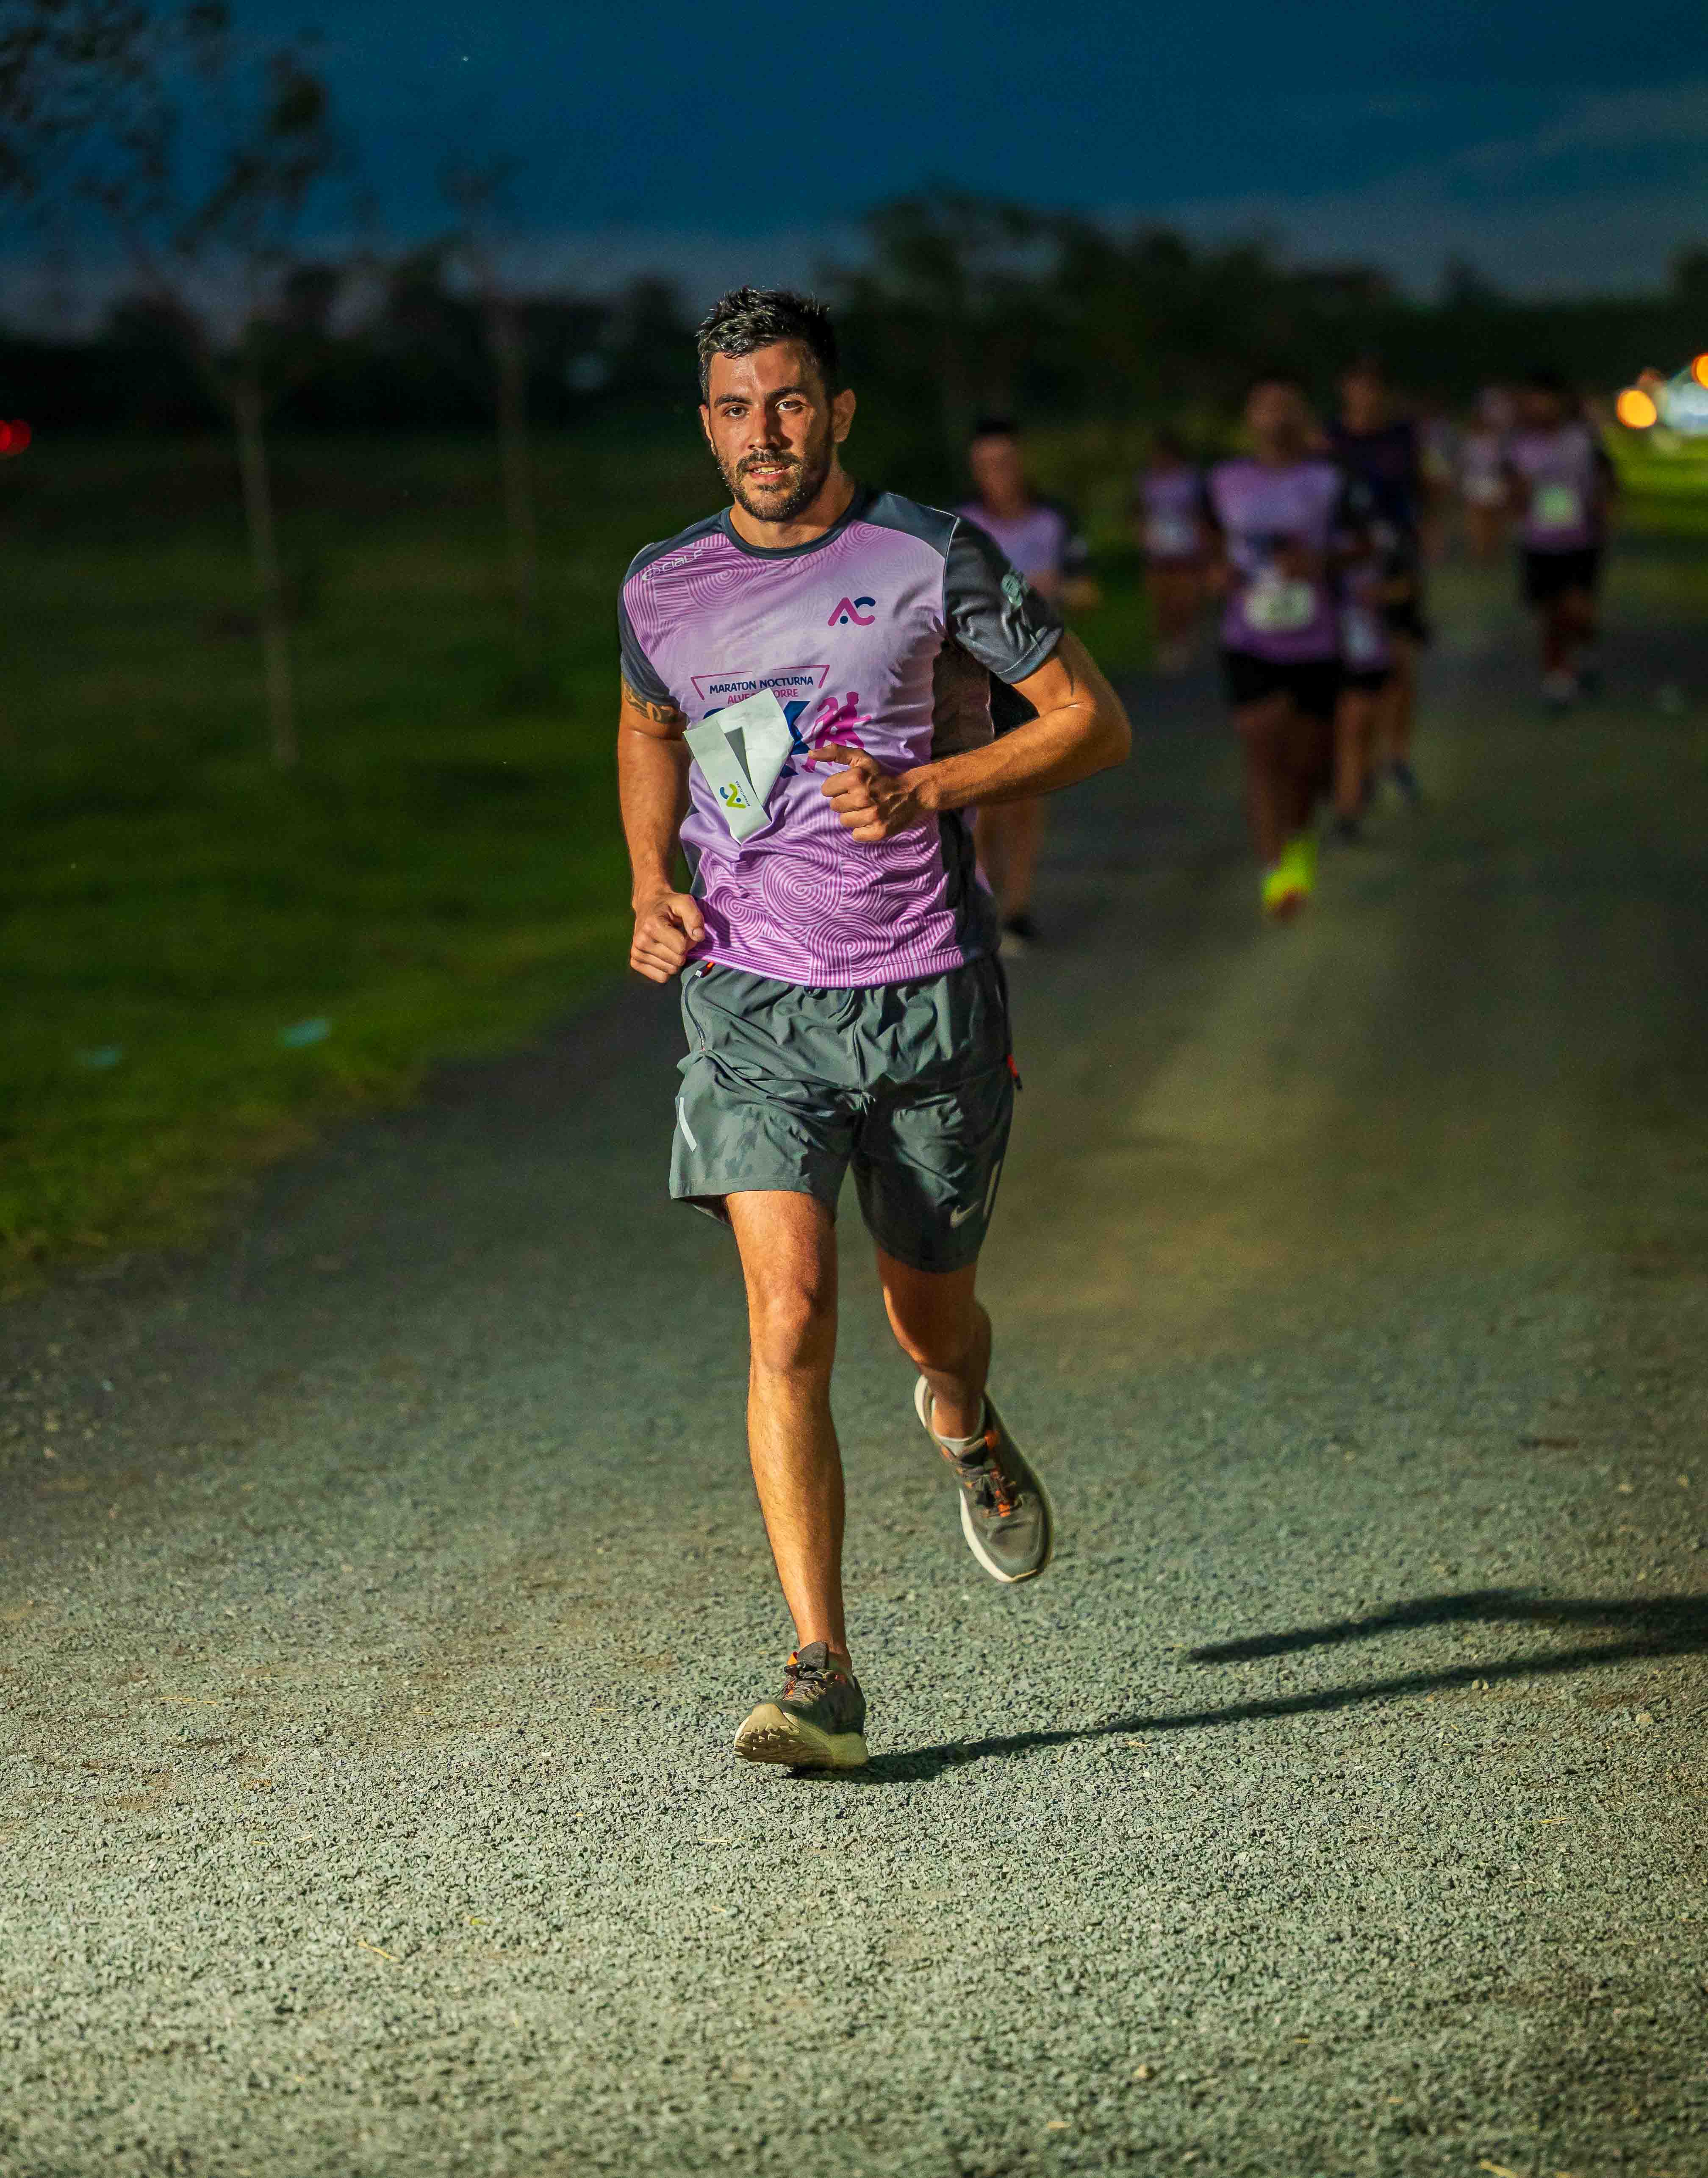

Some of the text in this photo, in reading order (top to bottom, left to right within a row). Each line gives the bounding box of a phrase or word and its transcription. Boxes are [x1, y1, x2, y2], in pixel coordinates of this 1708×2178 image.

[827, 597, 876, 626] AC
[710, 676, 813, 694] MARATON NOCTURNA
[772, 688, 799, 698] ORRE
